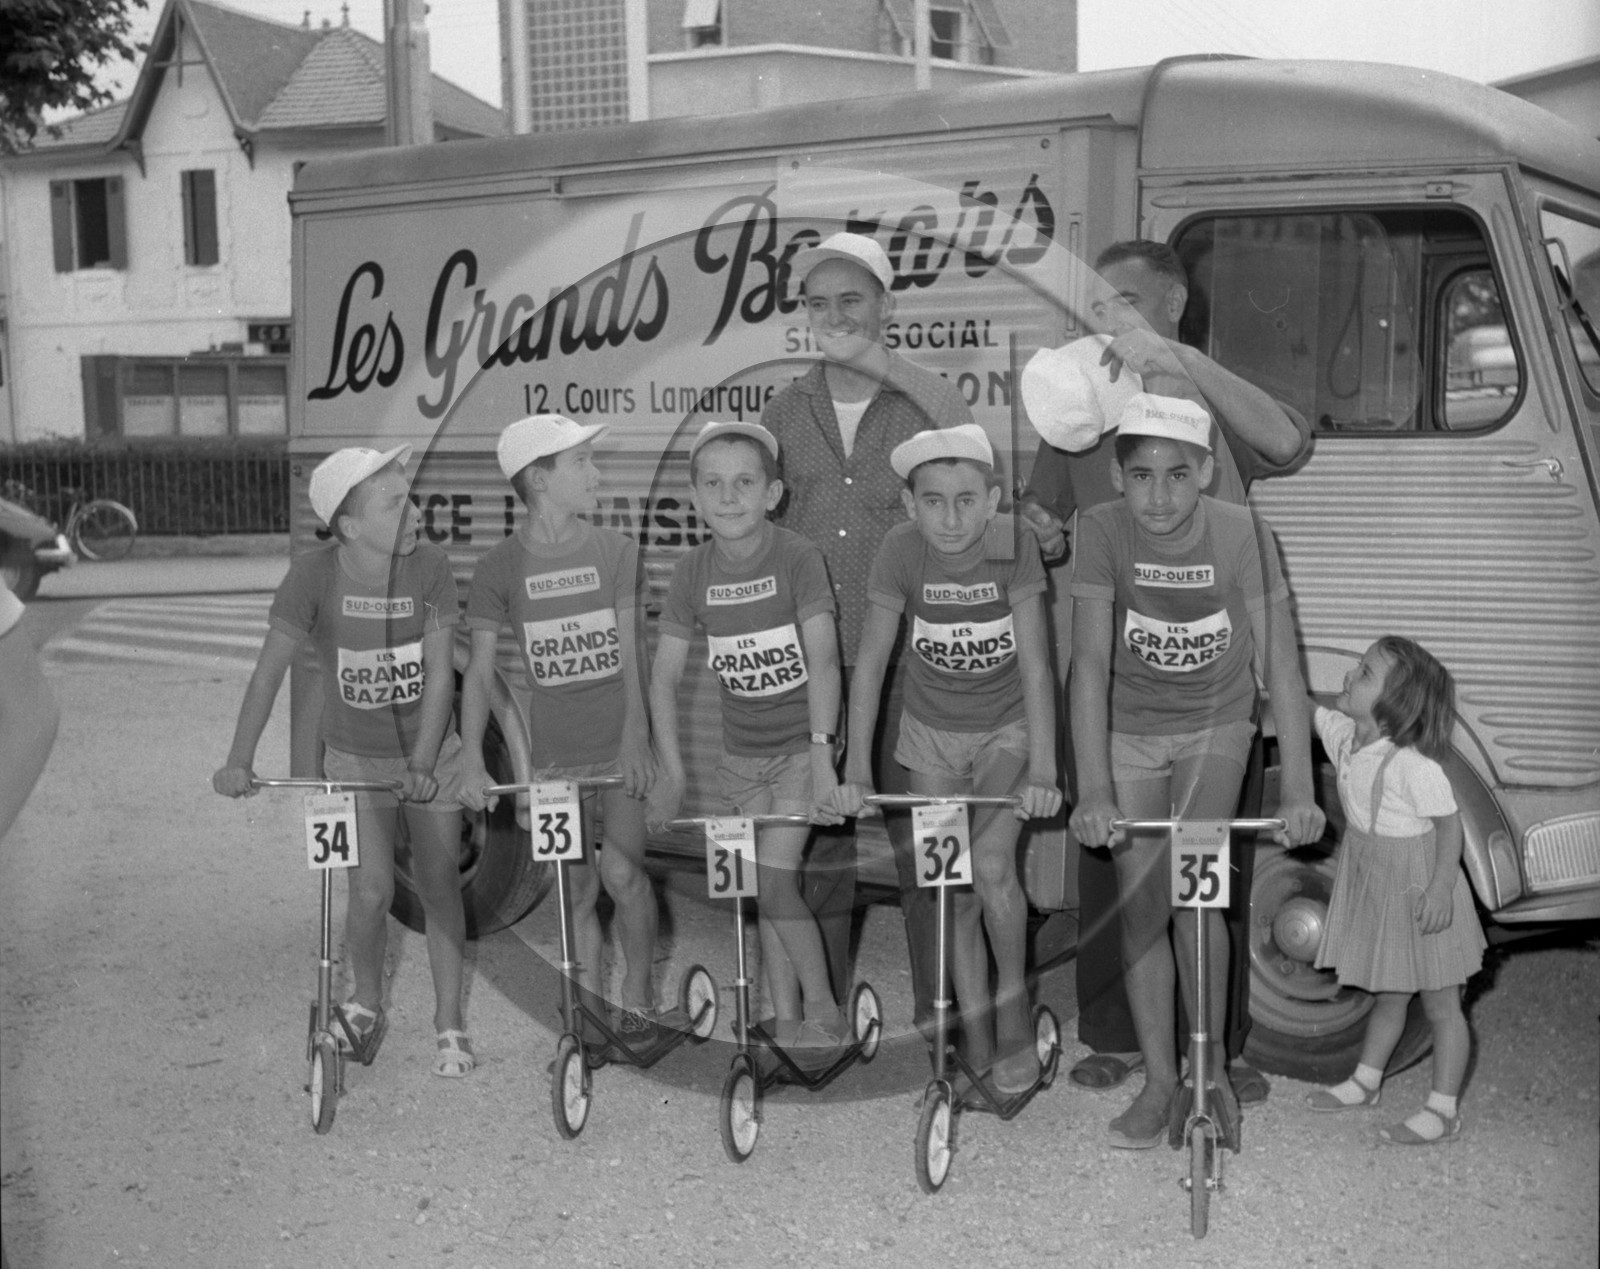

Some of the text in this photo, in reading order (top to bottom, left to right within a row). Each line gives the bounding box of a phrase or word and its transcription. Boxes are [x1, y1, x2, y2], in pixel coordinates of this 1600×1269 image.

[307, 261, 405, 401] Les
[416, 211, 670, 419] Grands
[885, 319, 999, 350] SOCIAL
[529, 573, 596, 592] SUD-OUEST
[1134, 568, 1211, 581] SUD-OUEST
[710, 580, 774, 598] SUD-OUEST
[925, 587, 995, 600] SUD-OUEST
[345, 600, 412, 612] SUD-OUEST
[561, 621, 581, 632] LES
[952, 628, 973, 638] LES
[1167, 625, 1189, 634] LES
[530, 627, 619, 657] GRANDS
[737, 638, 756, 649] LES
[915, 631, 1014, 657] GRANDS
[1128, 627, 1229, 650] GRANDS
[376, 652, 396, 662] LES
[533, 649, 620, 679] BAZARS
[712, 643, 799, 672] GRANDS
[341, 661, 425, 684] GRAND
[343, 681, 426, 704] BAZAR
[313, 820, 350, 863] 34
[537, 811, 572, 855] 33
[923, 835, 962, 880] 32
[713, 849, 744, 893] 31
[1178, 854, 1220, 902] 35
